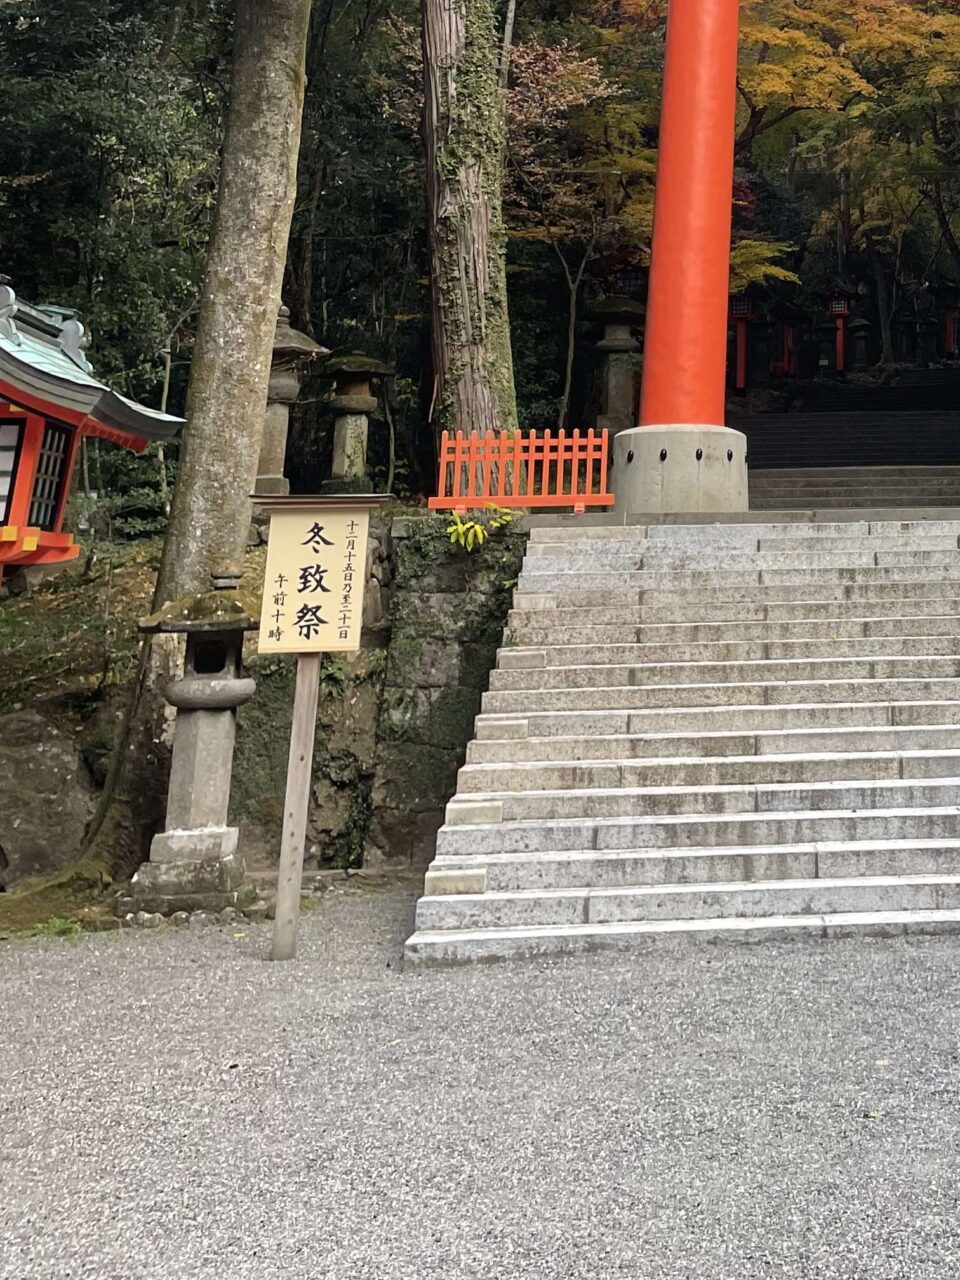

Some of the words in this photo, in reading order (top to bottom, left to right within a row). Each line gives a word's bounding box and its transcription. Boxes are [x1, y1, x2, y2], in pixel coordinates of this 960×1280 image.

[268, 573, 289, 641] 午前十時
[292, 522, 335, 640] 冬致祭
[338, 520, 359, 639] 十二月十五日乃至二十一日
